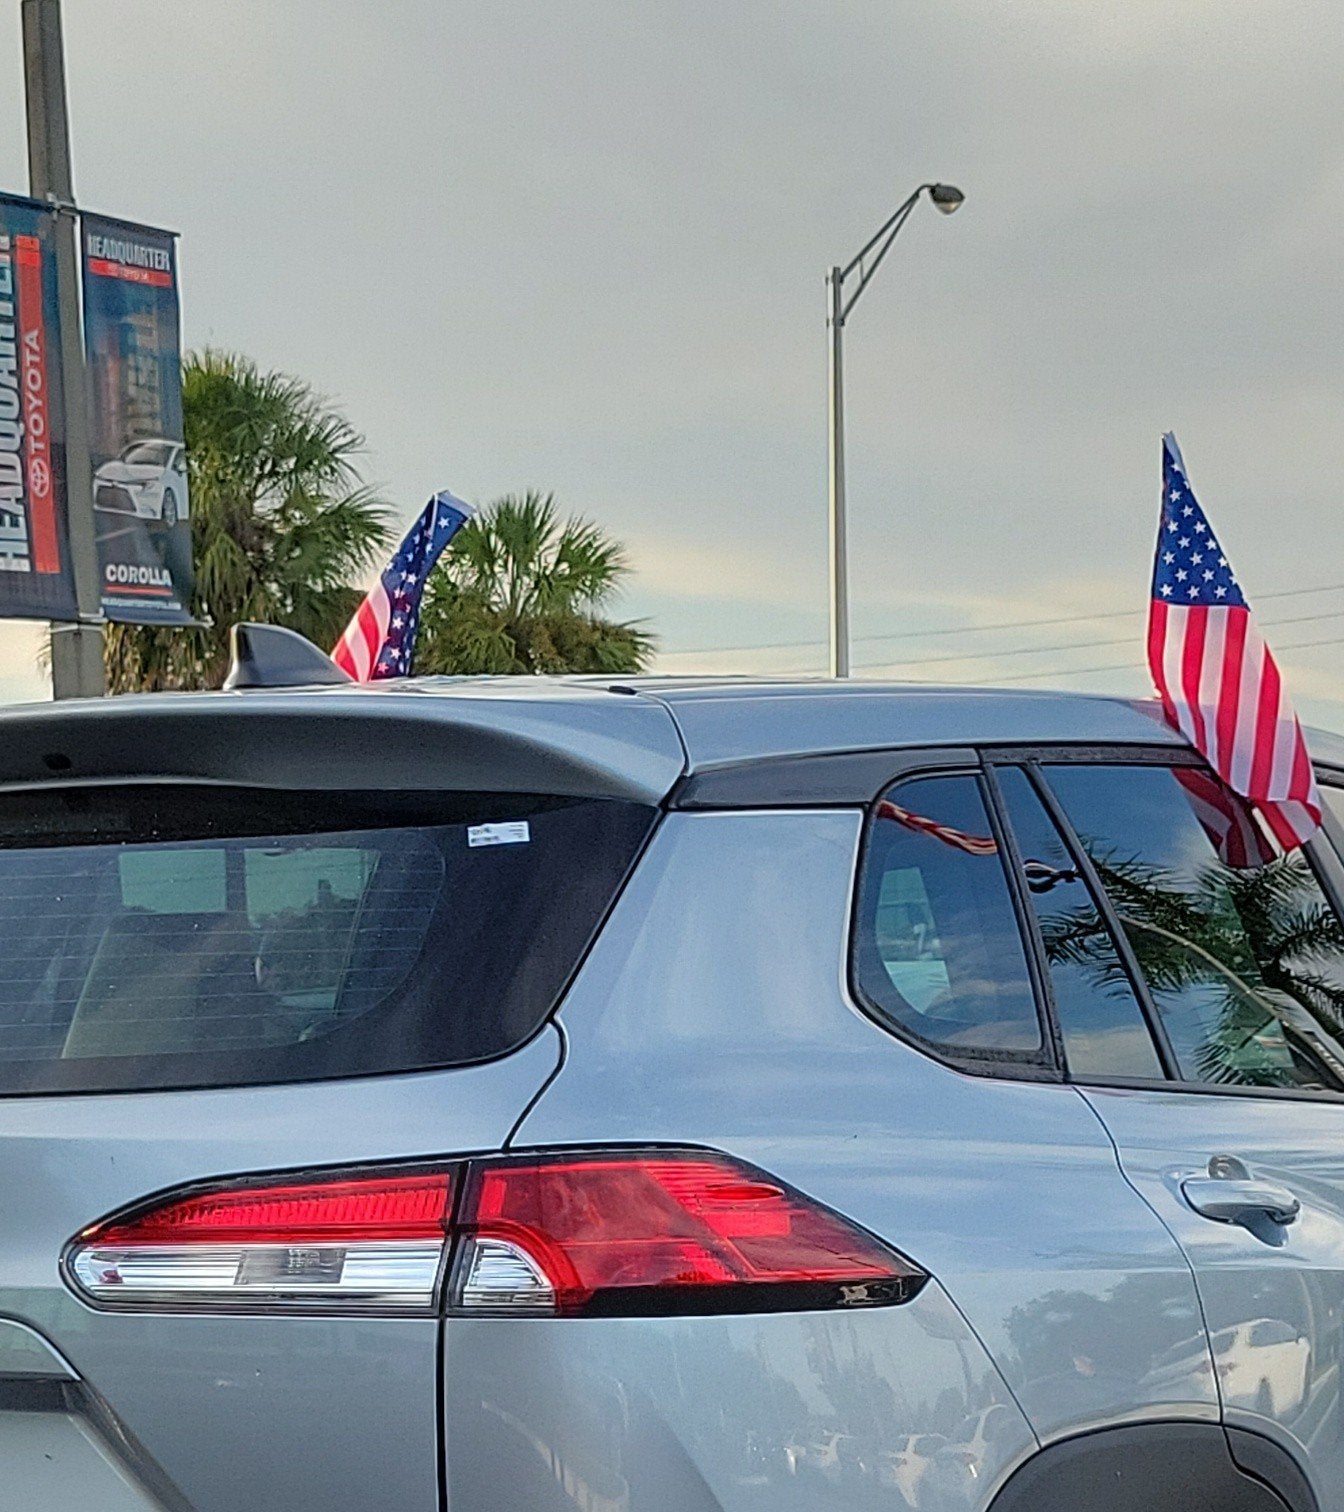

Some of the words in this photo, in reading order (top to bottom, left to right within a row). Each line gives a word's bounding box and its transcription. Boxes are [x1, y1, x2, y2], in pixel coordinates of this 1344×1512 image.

[87, 233, 171, 271] HEADQUARTER
[24, 329, 45, 455] TOYOTA
[105, 564, 173, 587] COROLLA
